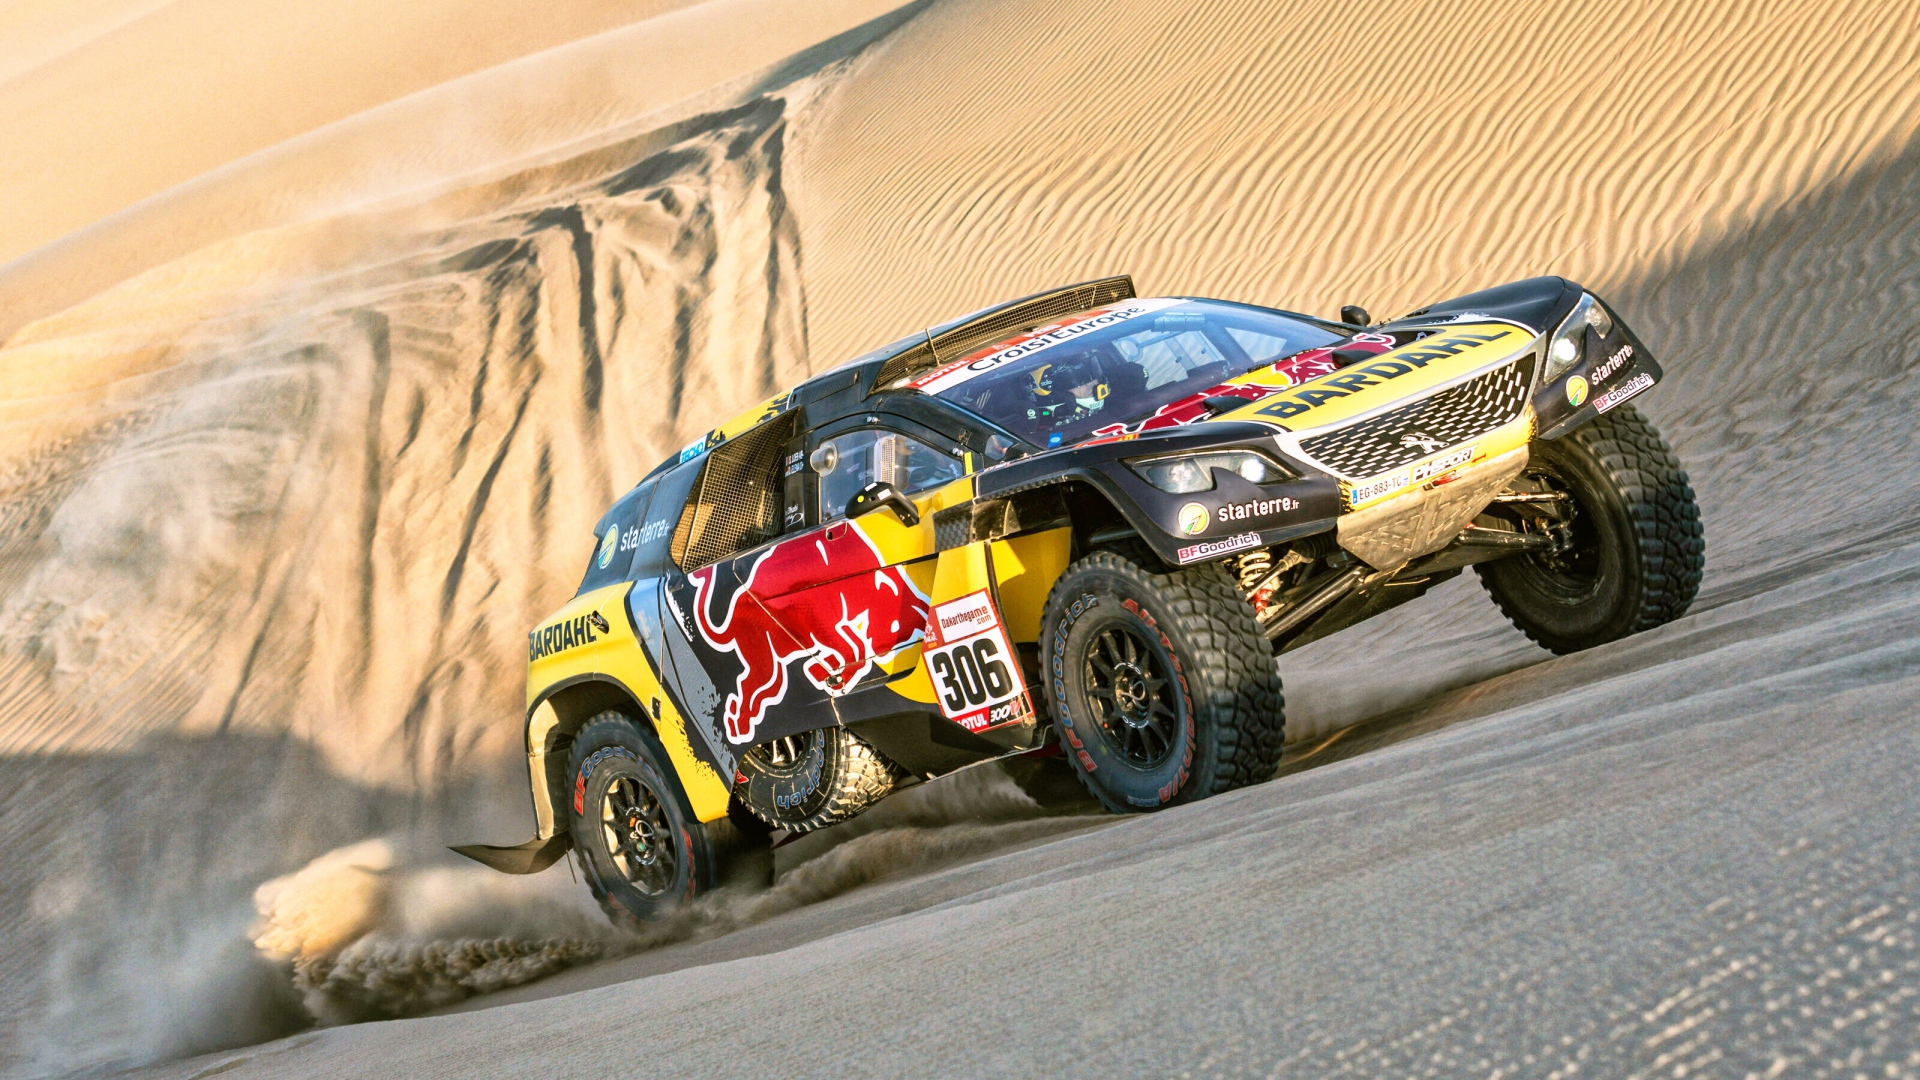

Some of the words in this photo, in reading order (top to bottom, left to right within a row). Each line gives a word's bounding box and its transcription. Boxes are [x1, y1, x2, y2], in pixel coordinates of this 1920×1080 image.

[967, 306, 1146, 371] CroisiEurope
[916, 359, 971, 386] MOTUL
[1254, 331, 1513, 418] BARDAHL
[1593, 372, 1651, 409] BFGoodrich
[1359, 475, 1403, 500] EG-883-TC
[1218, 497, 1300, 522] starterre.fr
[1179, 532, 1260, 560] BFGoodrich
[941, 605, 989, 630] Dakarthegame
[976, 614, 992, 626] .com
[529, 613, 597, 663] BARDAHL
[932, 637, 1014, 713] 306
[1053, 592, 1099, 772] BFGoodrich
